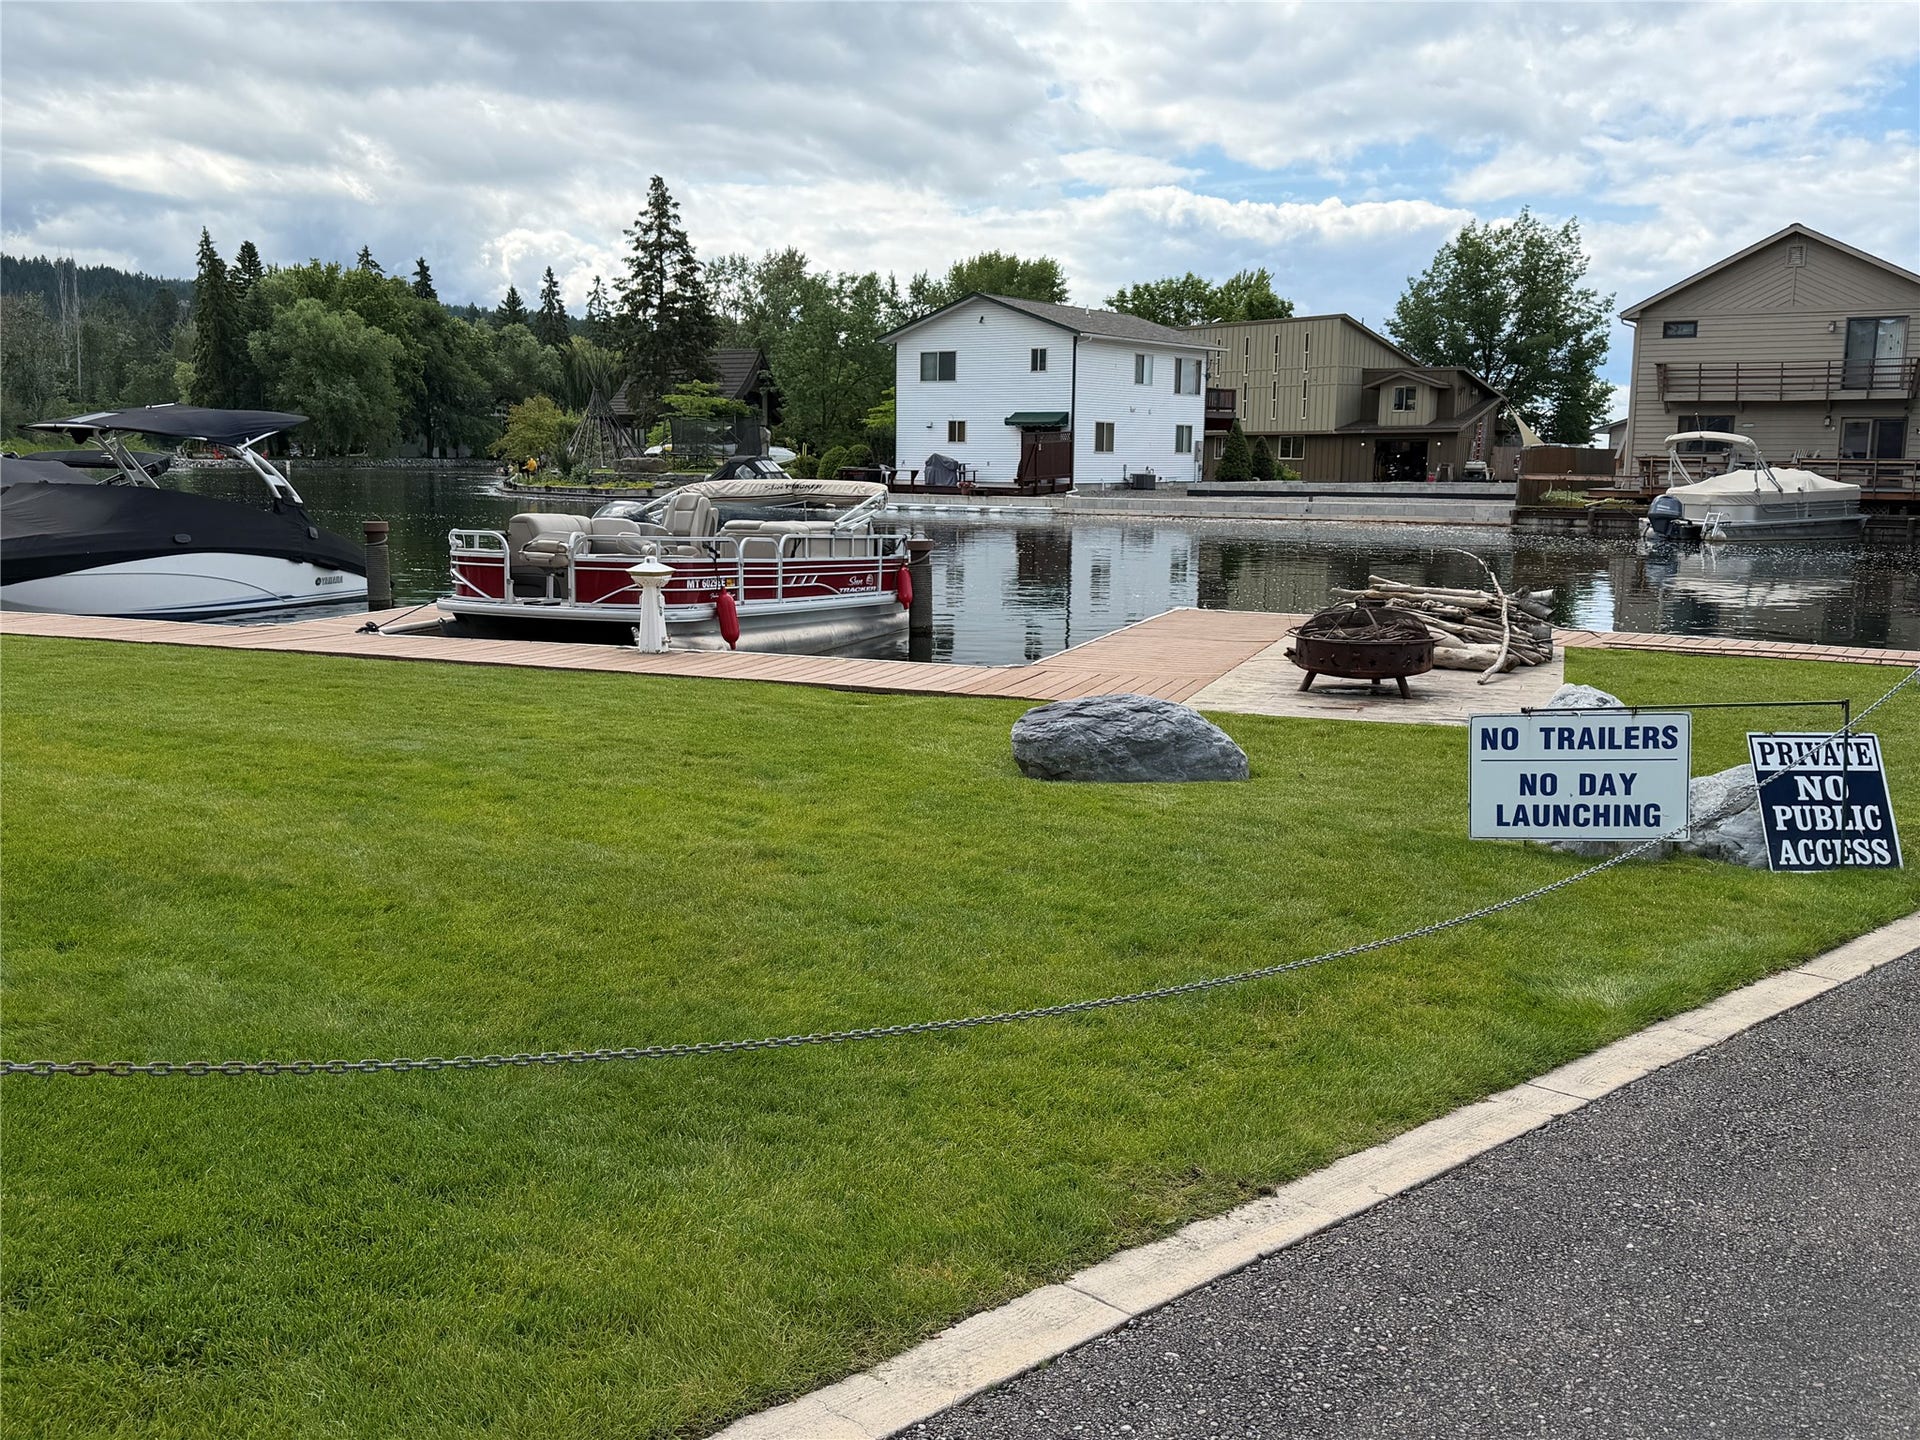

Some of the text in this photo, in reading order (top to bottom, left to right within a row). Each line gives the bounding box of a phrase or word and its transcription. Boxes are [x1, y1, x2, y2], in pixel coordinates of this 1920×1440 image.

[686, 579, 700, 589] MT
[1480, 725, 1679, 750] NO TRAILERS
[1757, 741, 1874, 766] PRIVATE
[1519, 773, 1638, 796] NO DAY
[1793, 775, 1850, 801] NO
[1496, 803, 1661, 827] LAUNCHING
[1772, 805, 1882, 831] PUBLIC
[1779, 838, 1892, 866] ACCESS
